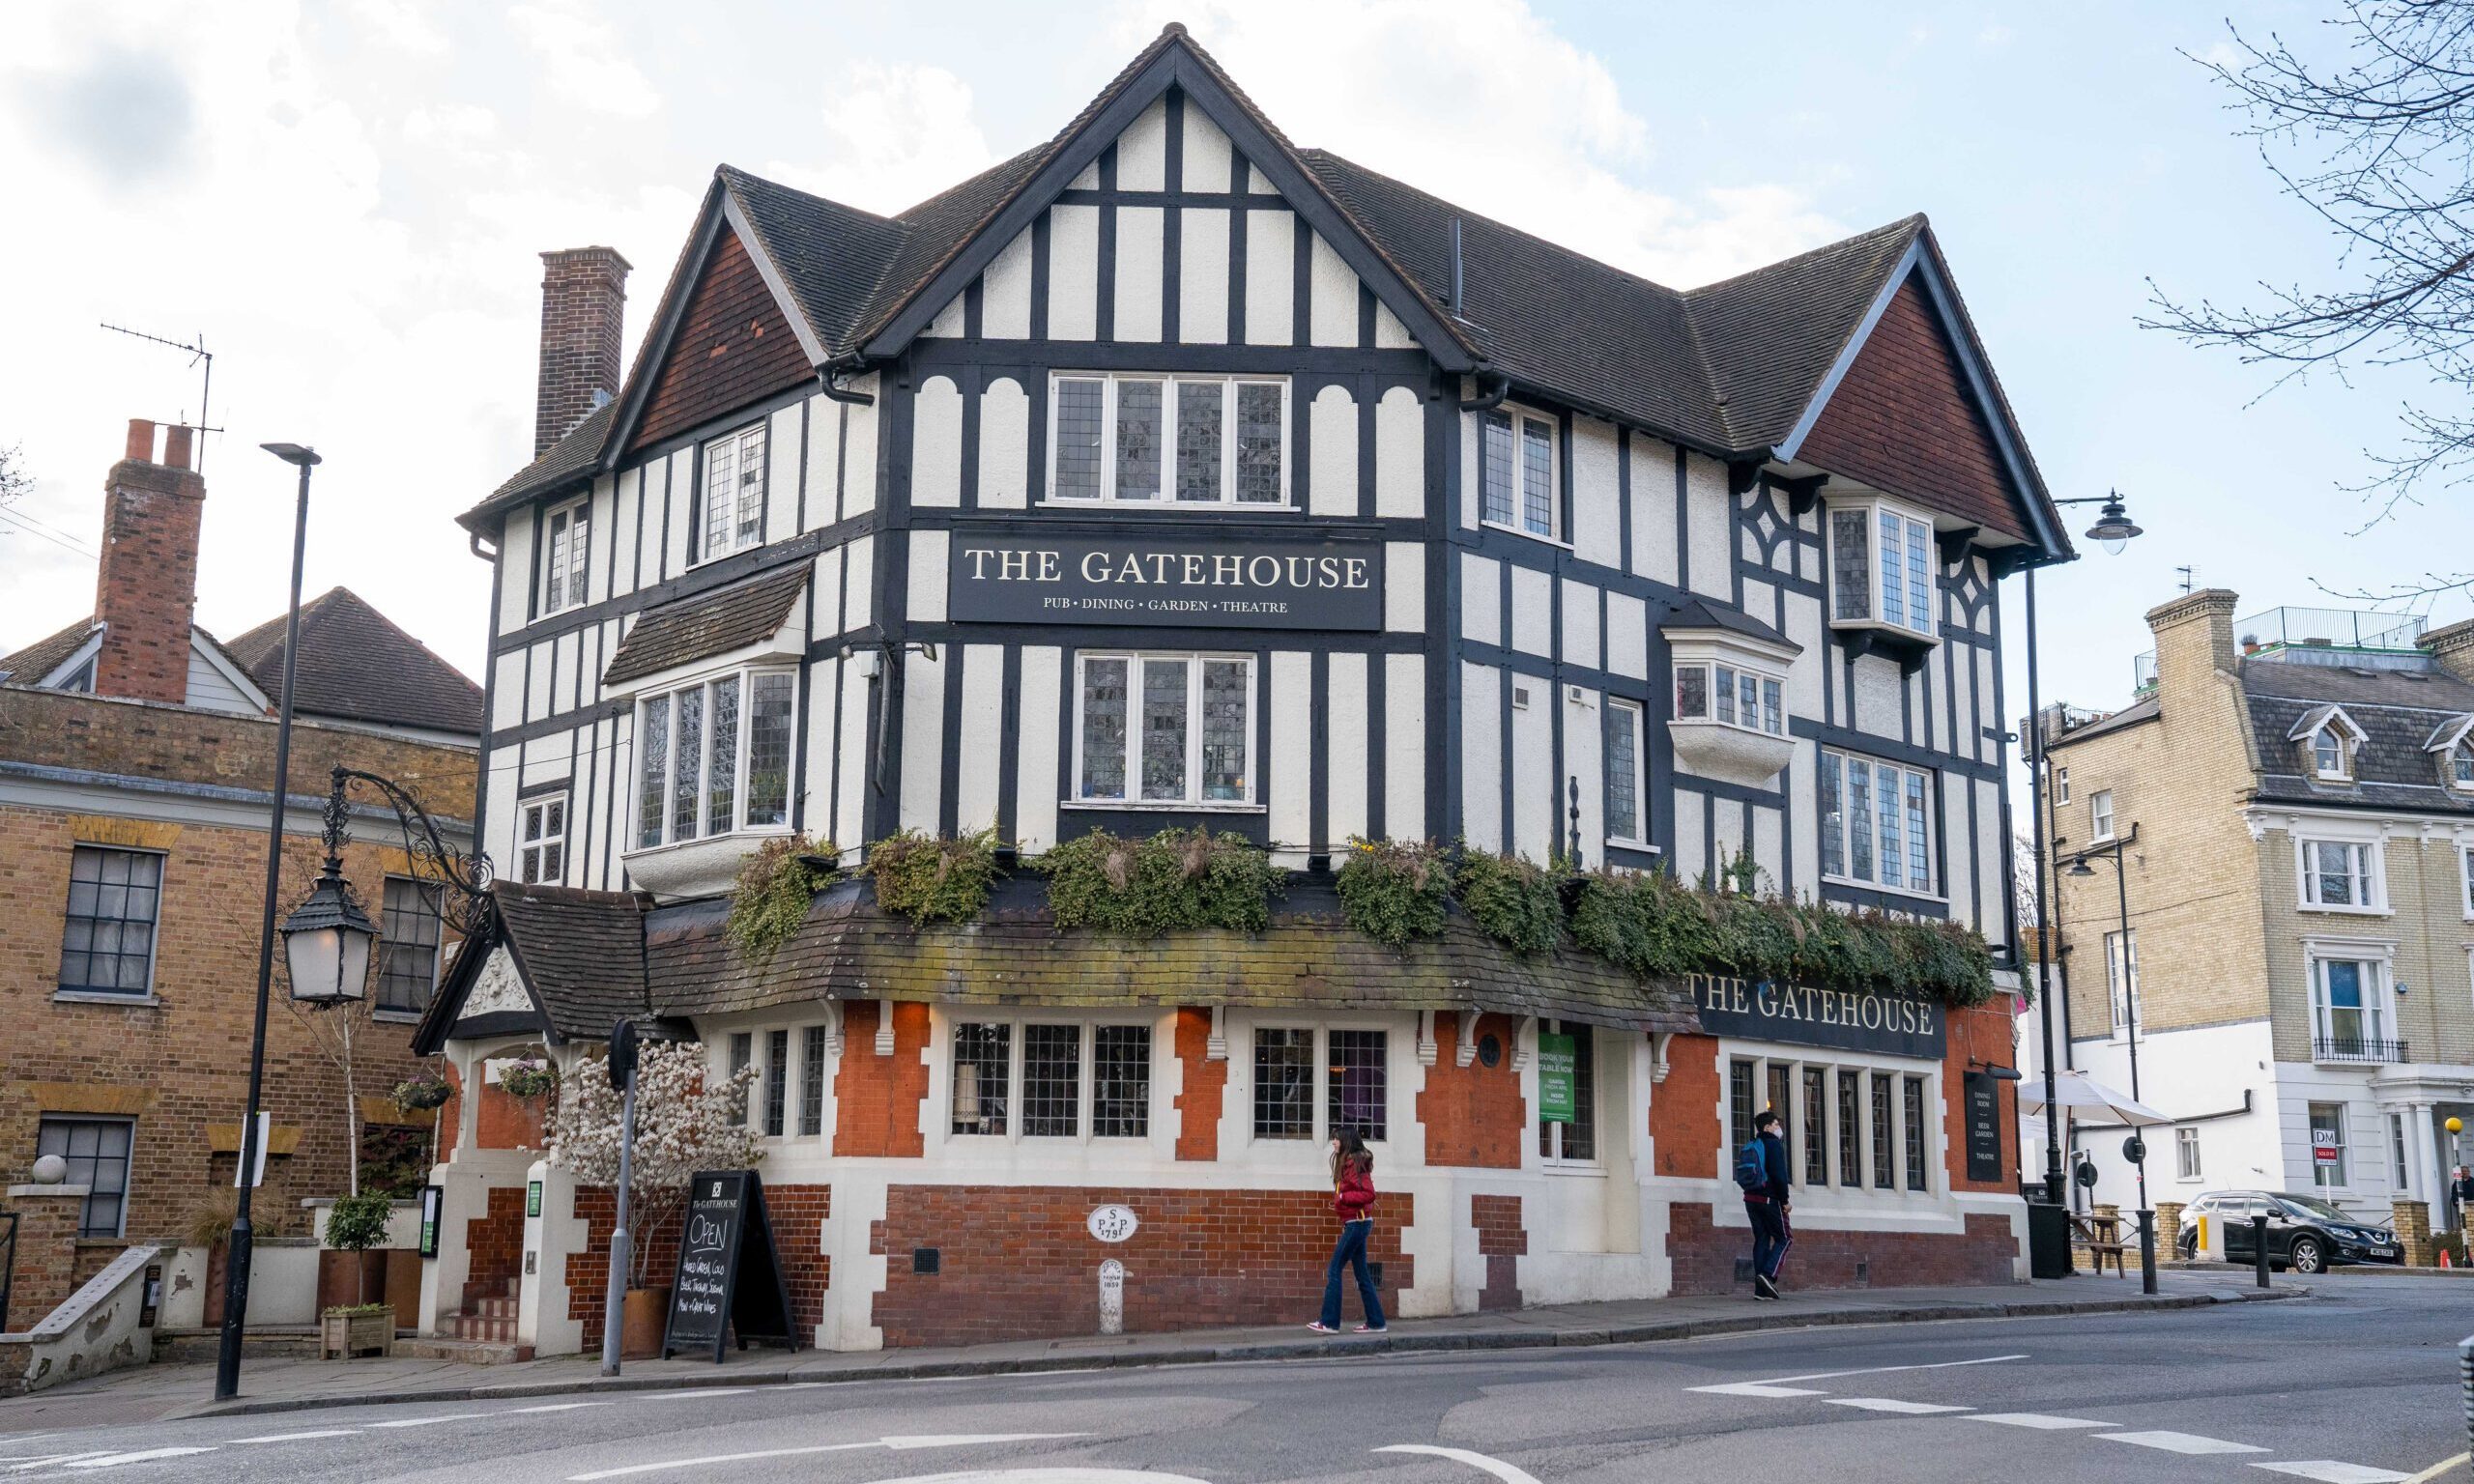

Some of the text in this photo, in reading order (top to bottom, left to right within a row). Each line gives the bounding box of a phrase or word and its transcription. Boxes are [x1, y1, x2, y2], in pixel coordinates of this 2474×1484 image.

[964, 549, 1369, 589] THE GATEHOUSE
[1044, 597, 1288, 614] PUB DINING GARDEN THEATRE
[1685, 972, 1934, 1036] THE GATEHOUSE
[1539, 1064, 1560, 1072] TABLE
[2316, 1131, 2335, 1144] DM
[701, 1199, 737, 1209] GATEHOUSE
[1109, 1209, 1117, 1219] S
[690, 1213, 729, 1249] OPEN
[1101, 1229, 1122, 1239] 1791
